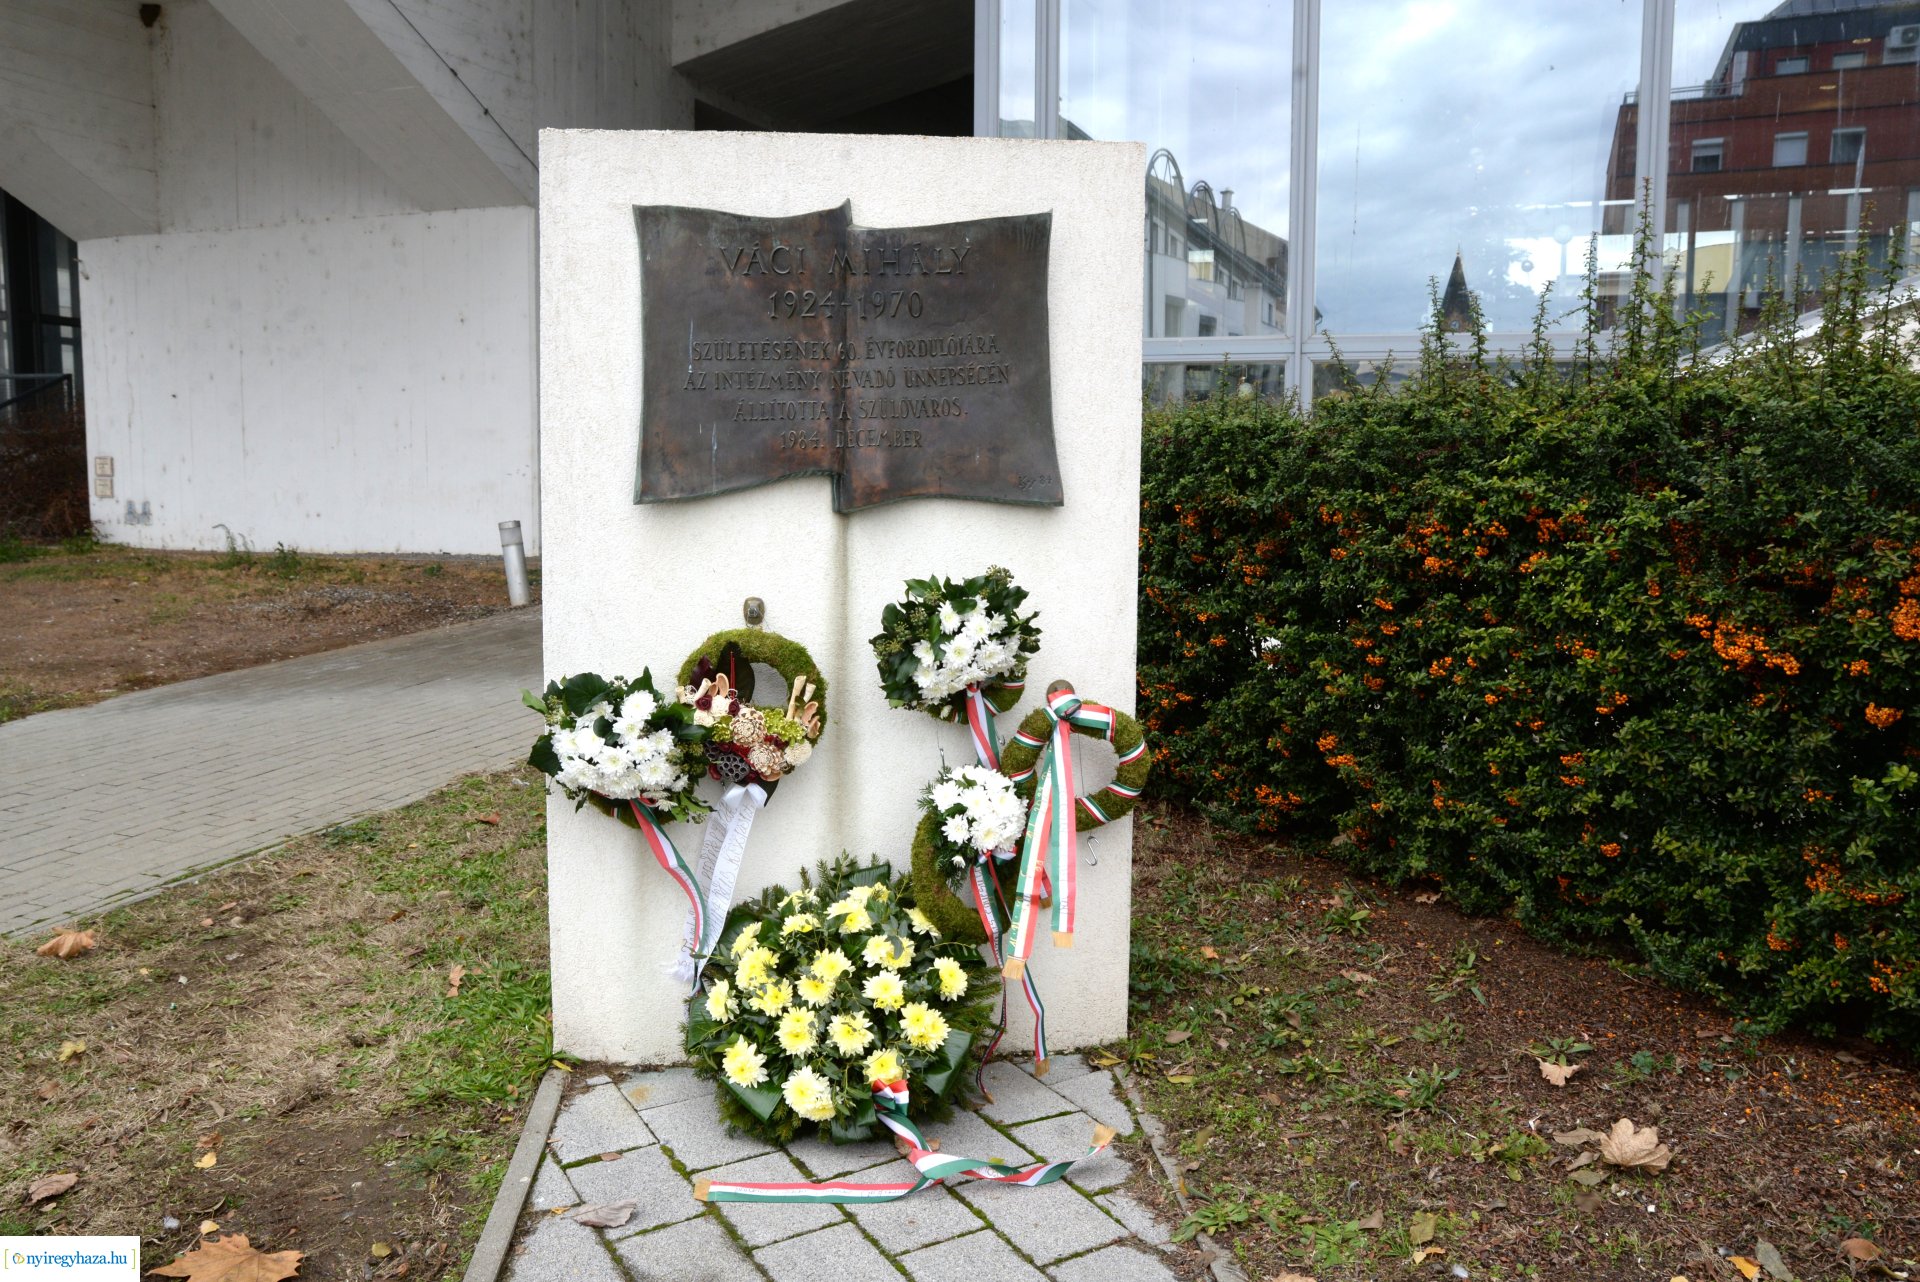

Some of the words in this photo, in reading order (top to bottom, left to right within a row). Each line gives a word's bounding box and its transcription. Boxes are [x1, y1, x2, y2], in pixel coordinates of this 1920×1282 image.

[719, 240, 806, 276] VÁCI
[827, 241, 972, 277] MIHÁLY
[692, 336, 832, 361] SZÜLETÉSÉNEK
[683, 371, 708, 391] AZ
[714, 367, 823, 391] INTÉZMÉNY
[830, 365, 896, 391] NÉVADÓ
[903, 360, 1010, 389] ÜNNEPSÉGÉN
[733, 398, 831, 423] ÁLLÍTOTTA
[838, 400, 852, 420] A
[835, 429, 923, 449] DECEMBER
